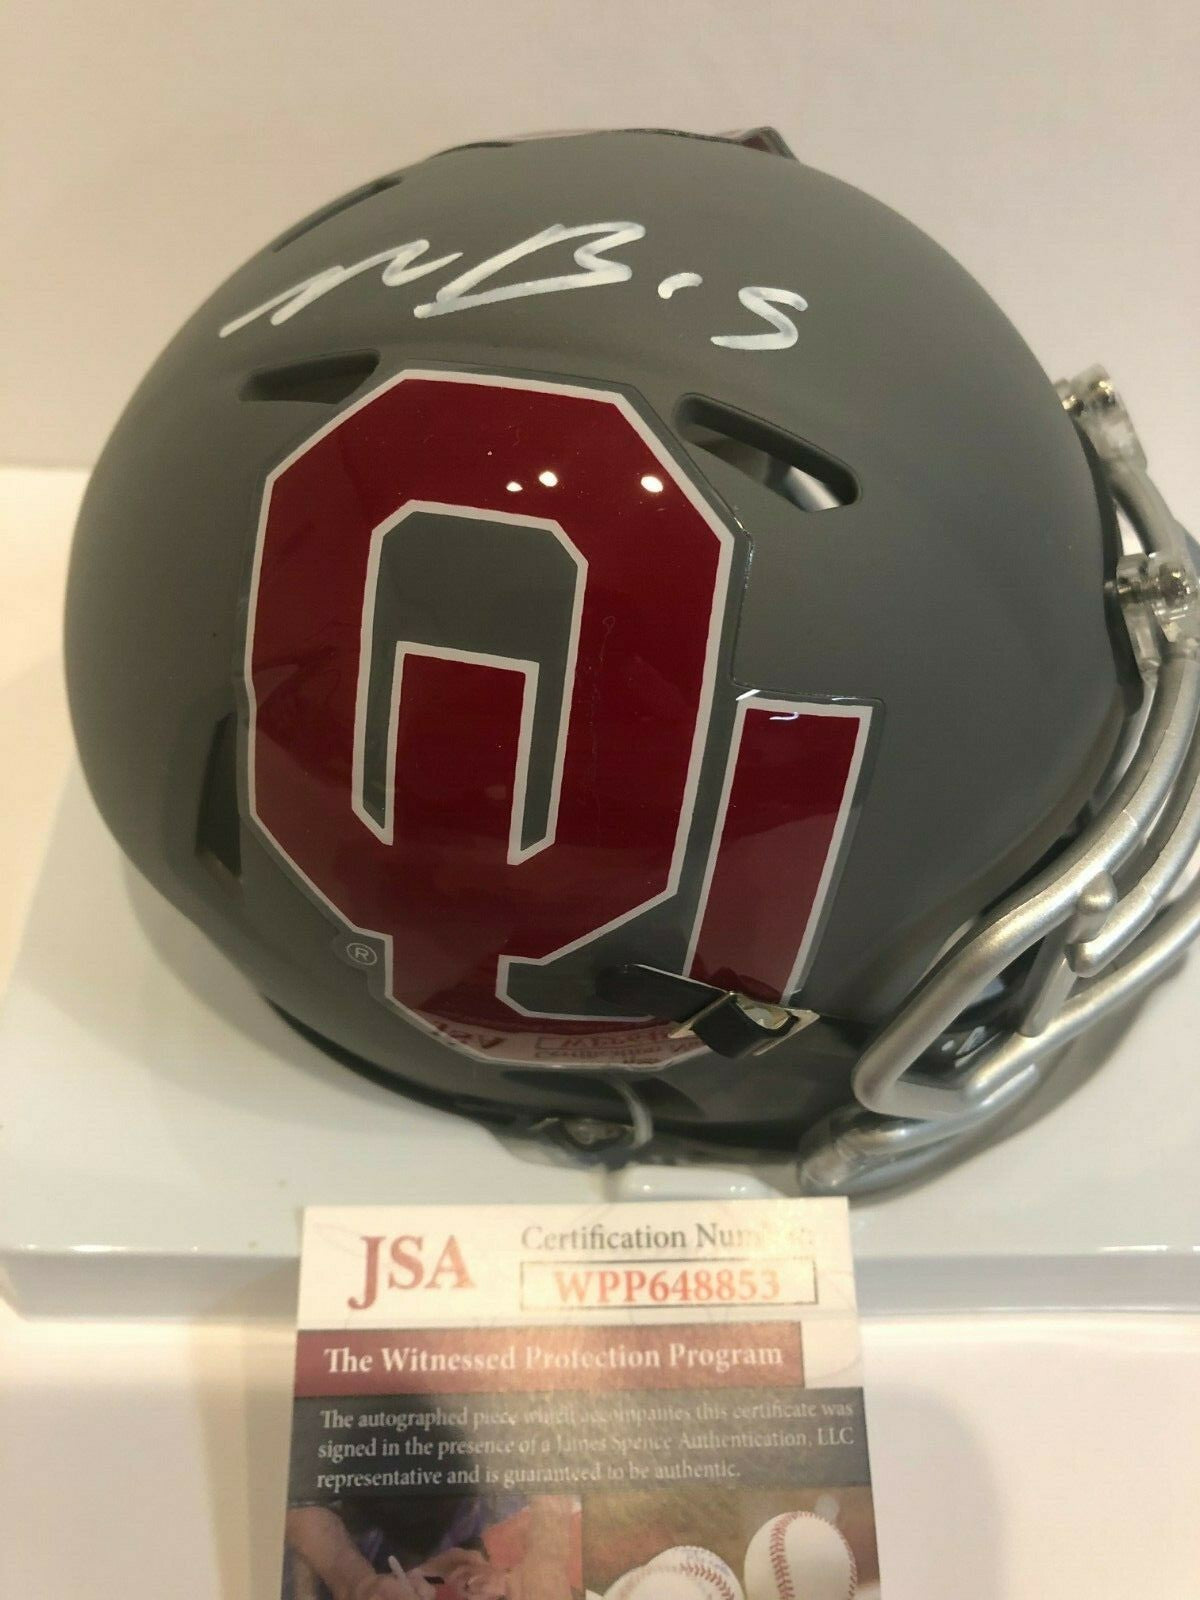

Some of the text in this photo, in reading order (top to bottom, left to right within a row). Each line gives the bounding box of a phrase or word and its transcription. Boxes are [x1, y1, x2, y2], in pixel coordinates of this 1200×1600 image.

[520, 1224, 686, 1251] Certification
[347, 1234, 475, 1310] JSA
[553, 1269, 780, 1304] WPP648853
[324, 1341, 783, 1373] The Witnessed Protection Program
[320, 1410, 352, 1428] The
[357, 1407, 468, 1432] autographed
[696, 1401, 727, 1420] this
[732, 1398, 817, 1419] certificate
[822, 1401, 854, 1416] was
[317, 1438, 377, 1463] signed
[382, 1439, 400, 1457] in
[405, 1436, 434, 1456] the
[437, 1438, 515, 1460] presence
[518, 1435, 536, 1456] of
[613, 1431, 672, 1453] Spence
[678, 1427, 813, 1450] Authentication,
[817, 1426, 855, 1446] LLC
[316, 1459, 741, 1494] representative and is guaranteed to be authentic.
